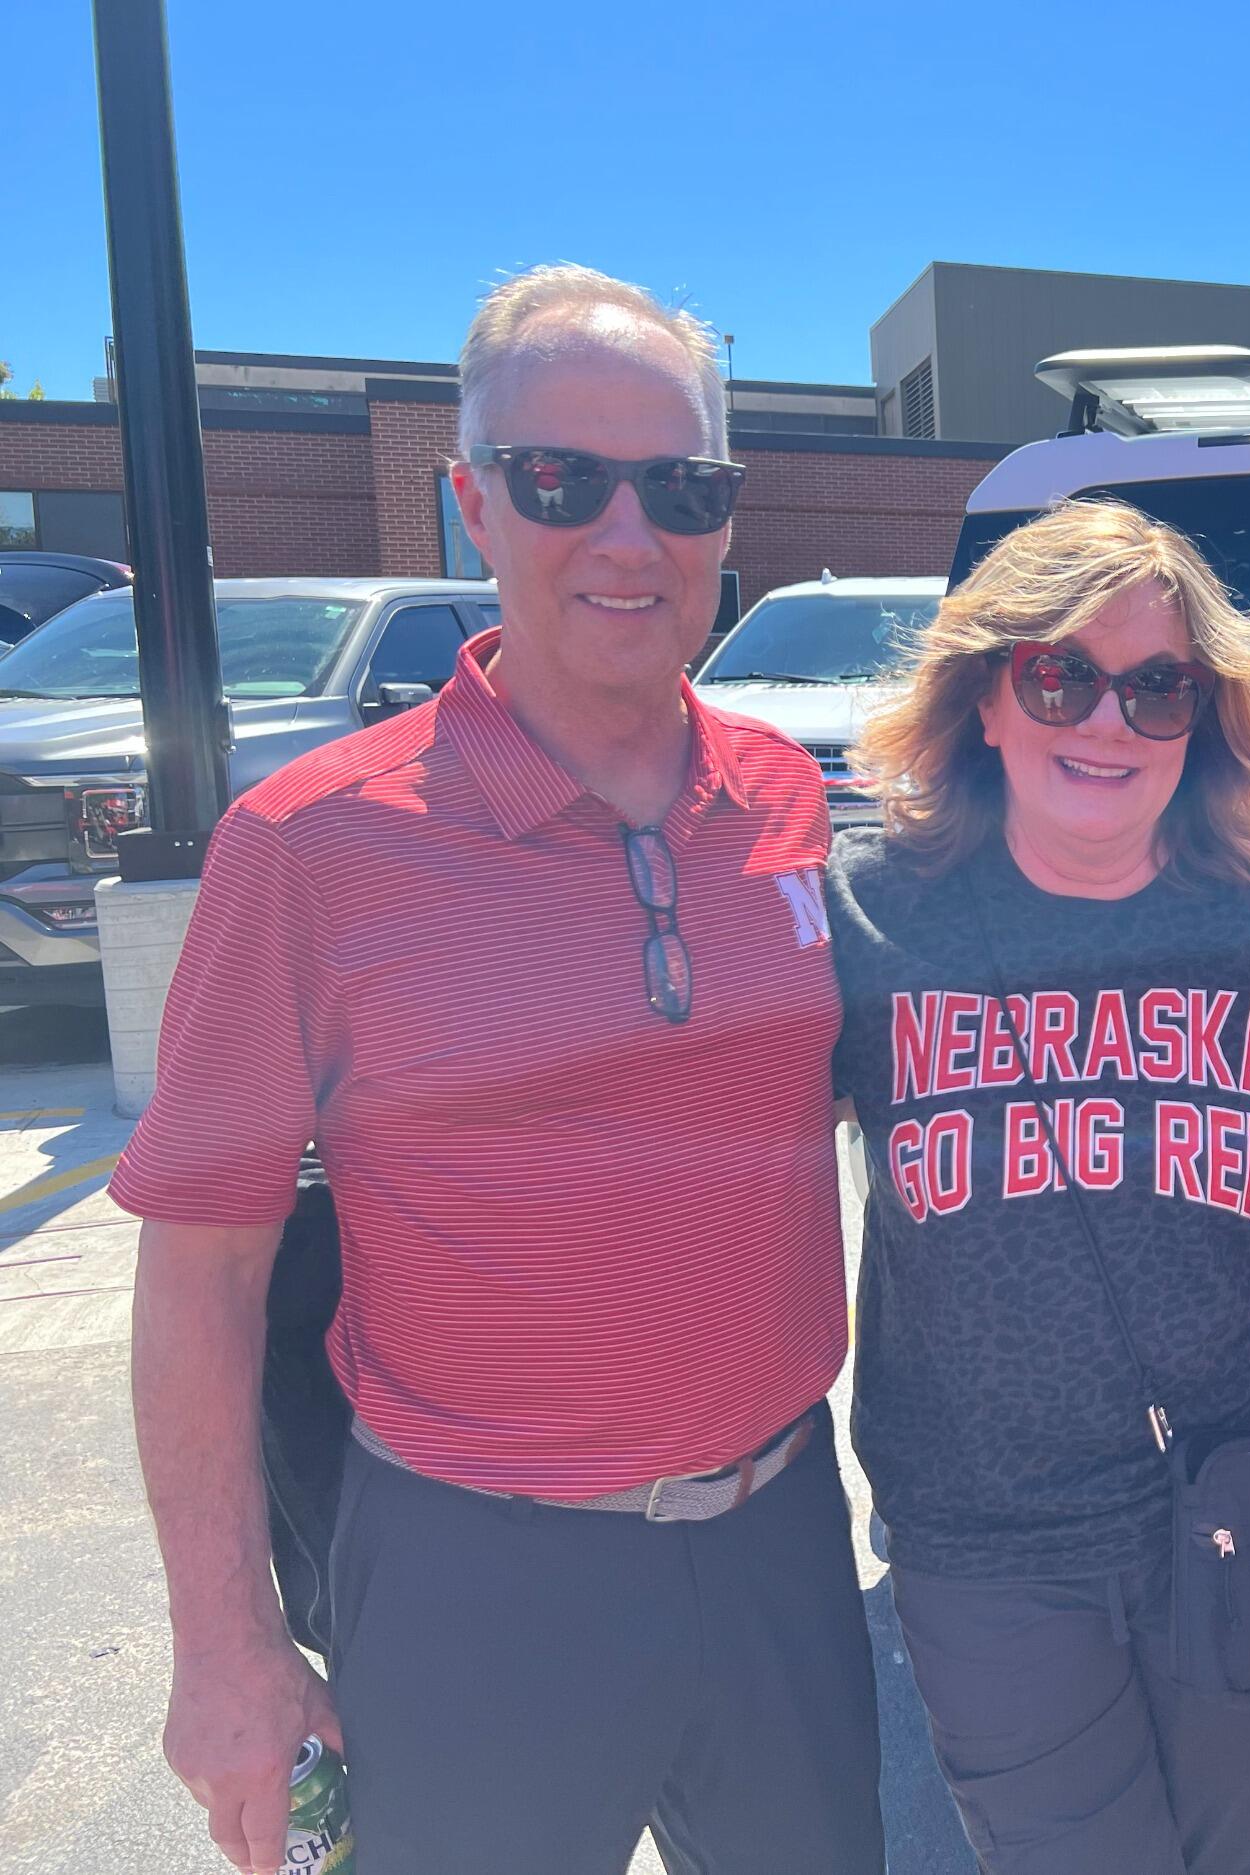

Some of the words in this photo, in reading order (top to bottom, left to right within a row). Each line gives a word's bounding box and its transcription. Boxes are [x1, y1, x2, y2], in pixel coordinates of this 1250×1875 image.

[774, 867, 832, 949] N
[888, 1108, 974, 1224] GO
[1002, 1098, 1125, 1199] BIG
